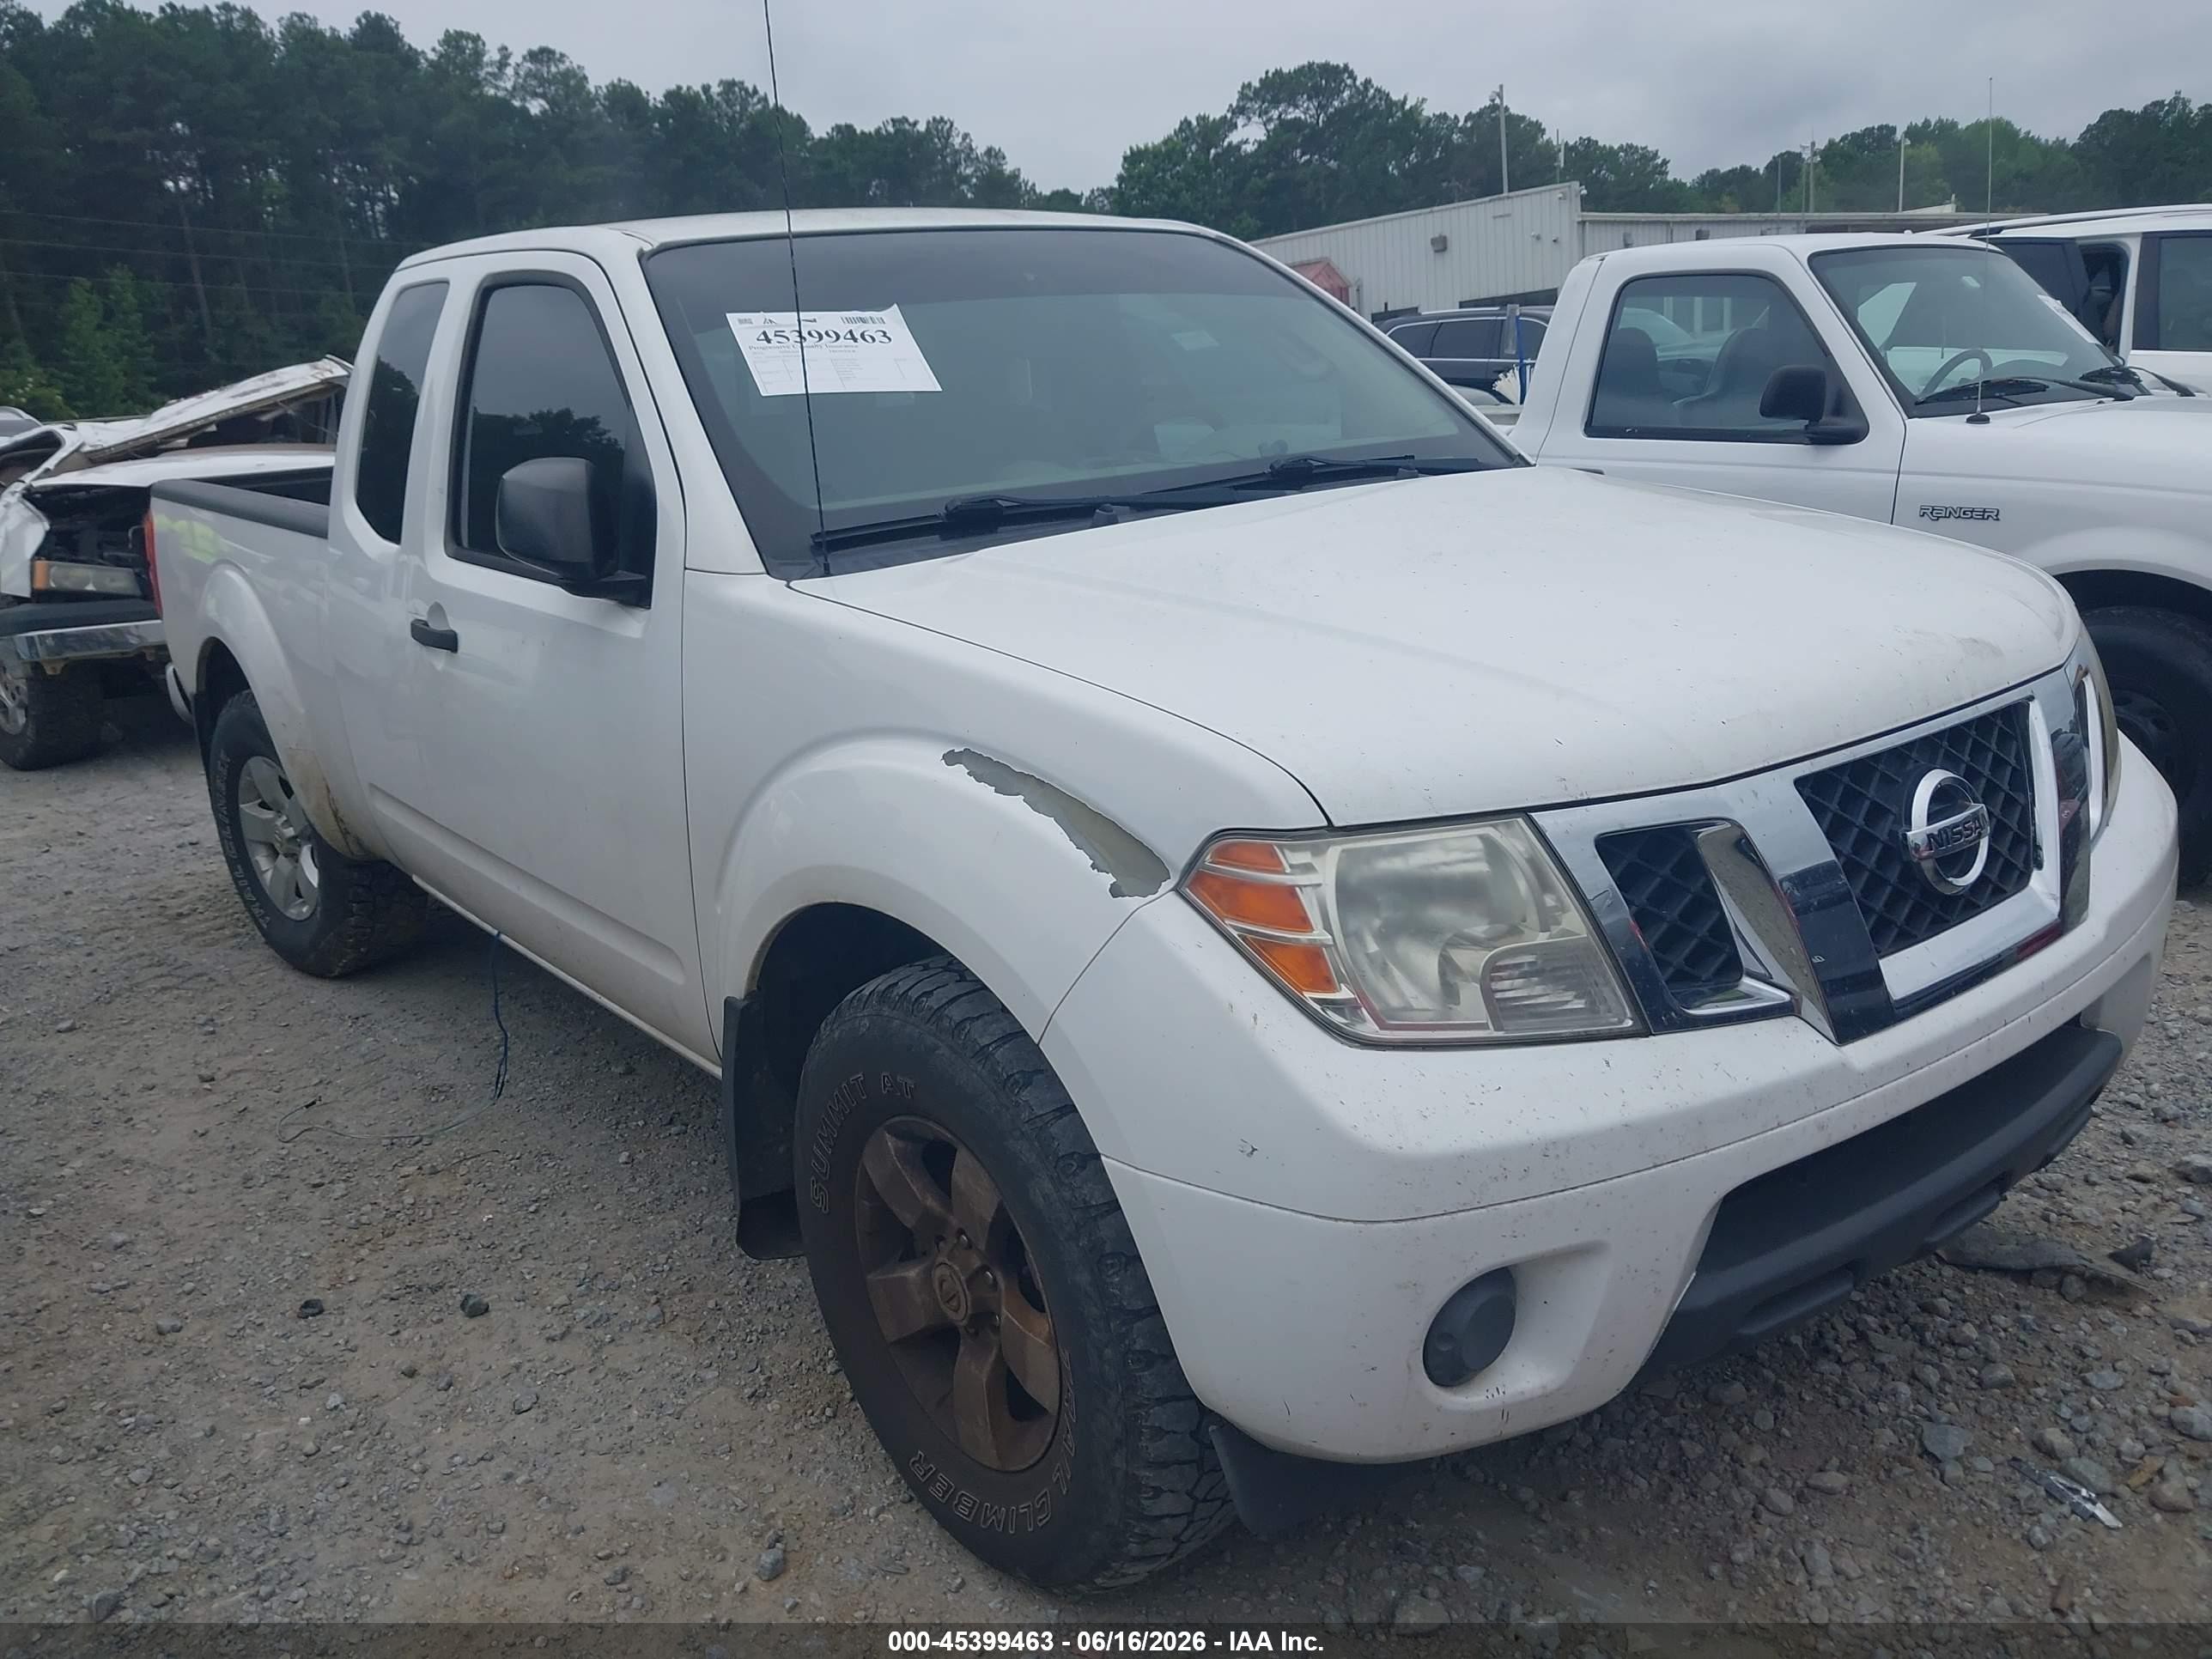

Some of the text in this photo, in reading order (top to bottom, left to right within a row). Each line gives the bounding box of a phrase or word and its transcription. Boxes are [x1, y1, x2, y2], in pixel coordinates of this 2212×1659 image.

[756, 329, 892, 344] 45399463
[1919, 505, 2001, 521] RANGER
[811, 1071, 916, 1214] SUMMIT AT
[908, 1449, 1053, 1535] CLIMBER
